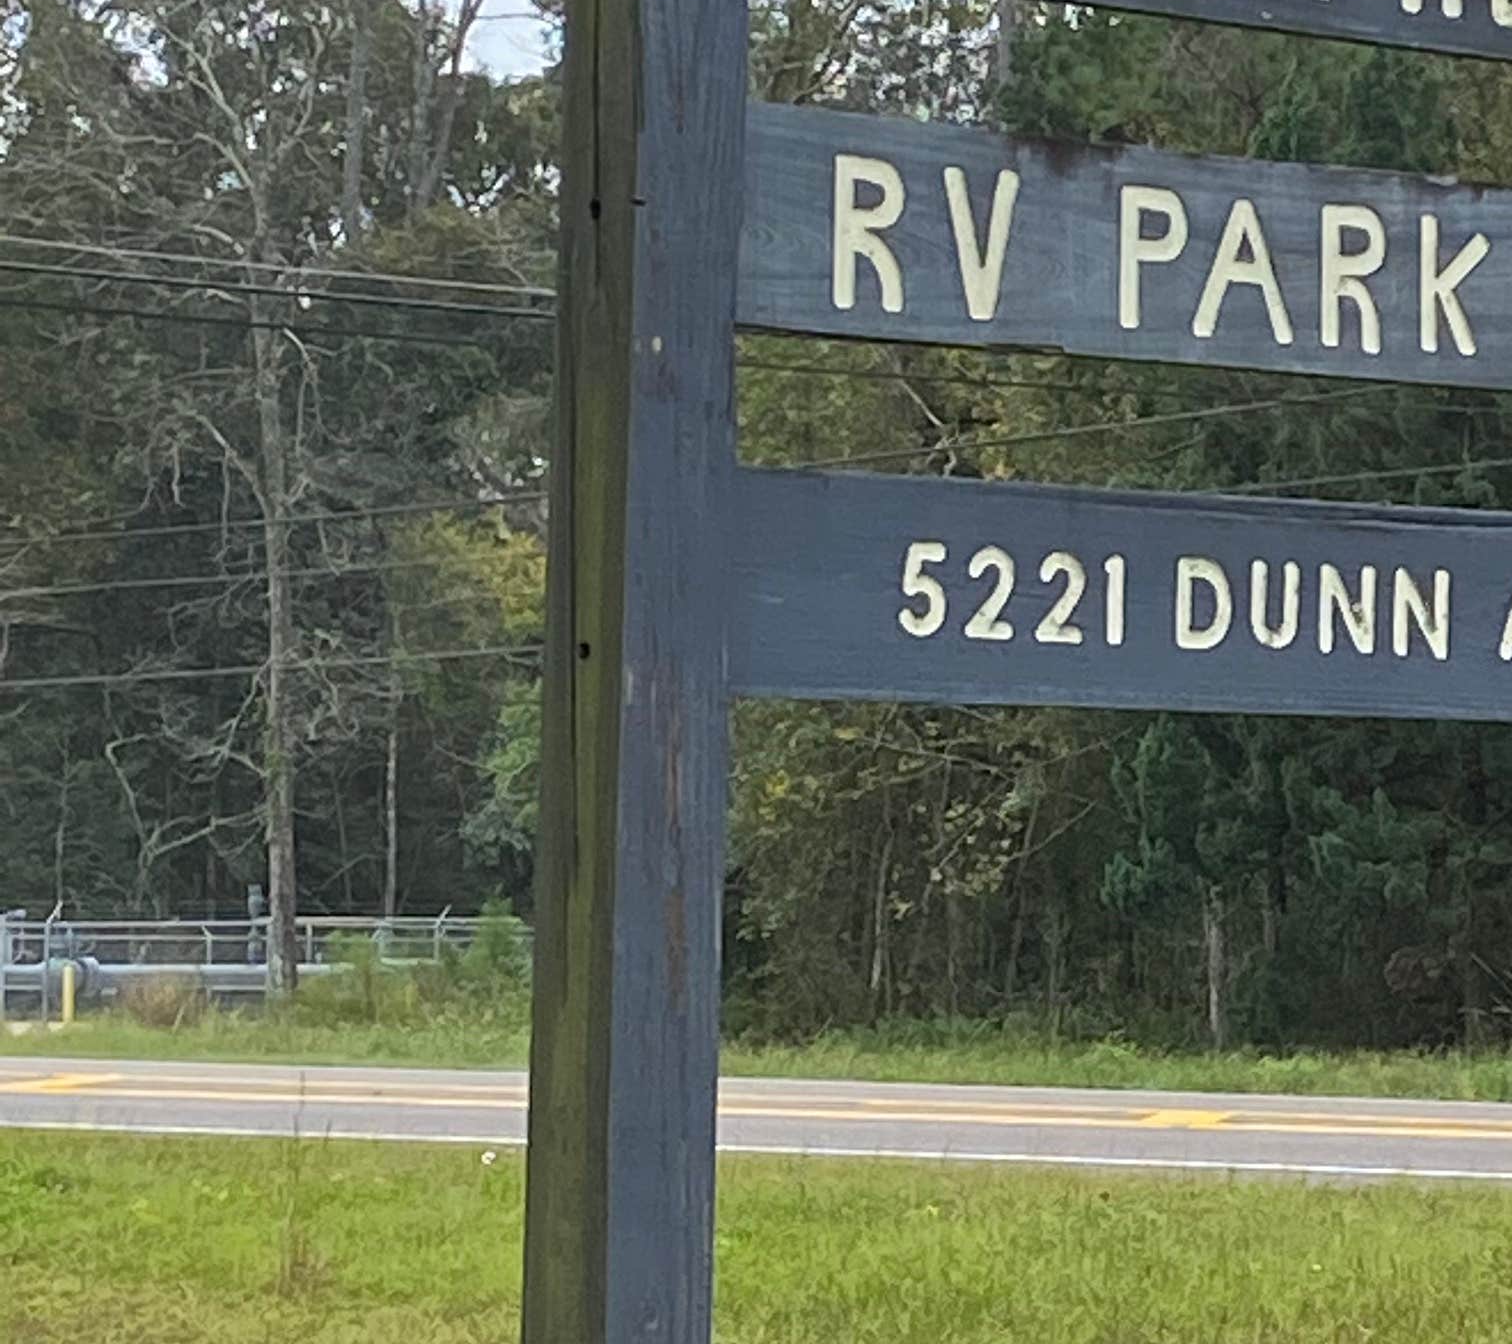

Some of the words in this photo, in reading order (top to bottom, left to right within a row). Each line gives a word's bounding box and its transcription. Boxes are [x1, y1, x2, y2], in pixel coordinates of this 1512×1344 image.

[832, 154, 1020, 322] RV
[897, 541, 1125, 646] 5221
[1174, 557, 1451, 661] DUNN
